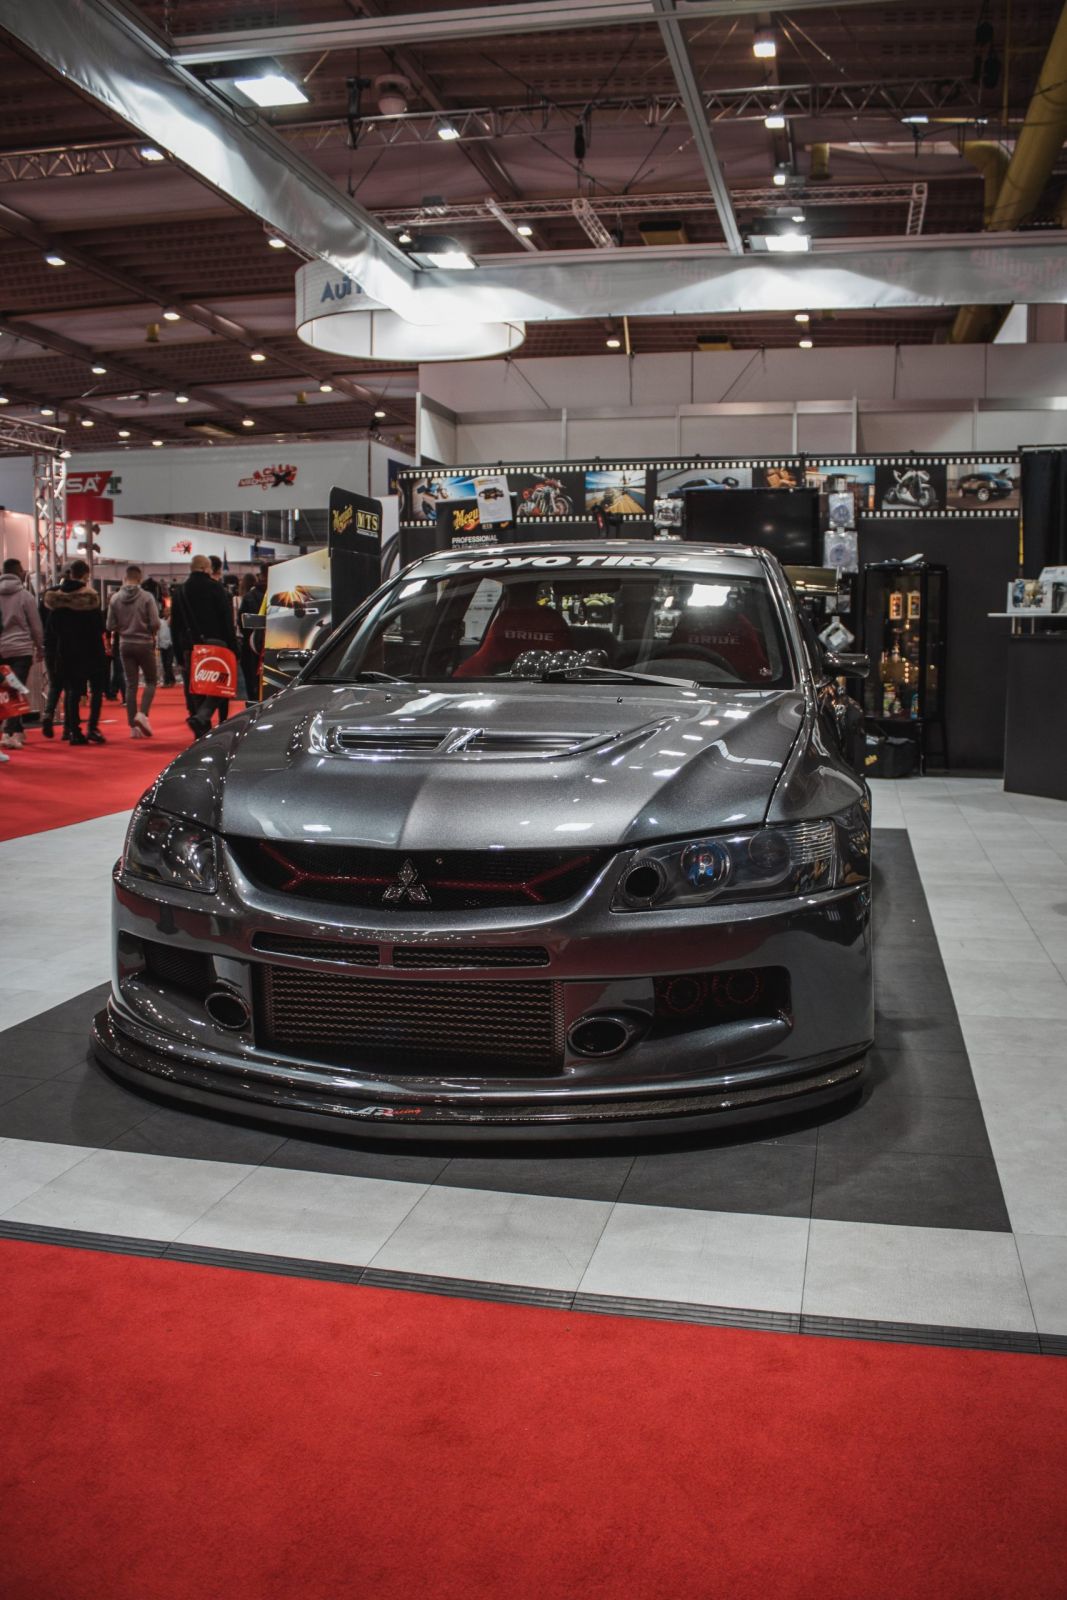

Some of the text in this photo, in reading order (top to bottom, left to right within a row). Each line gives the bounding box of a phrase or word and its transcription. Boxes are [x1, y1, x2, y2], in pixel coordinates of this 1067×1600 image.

[452, 534, 498, 544] PROFESSIONAL
[446, 556, 573, 571] TOYO
[504, 630, 554, 642] BRIDE
[687, 634, 742, 645] BRIDE
